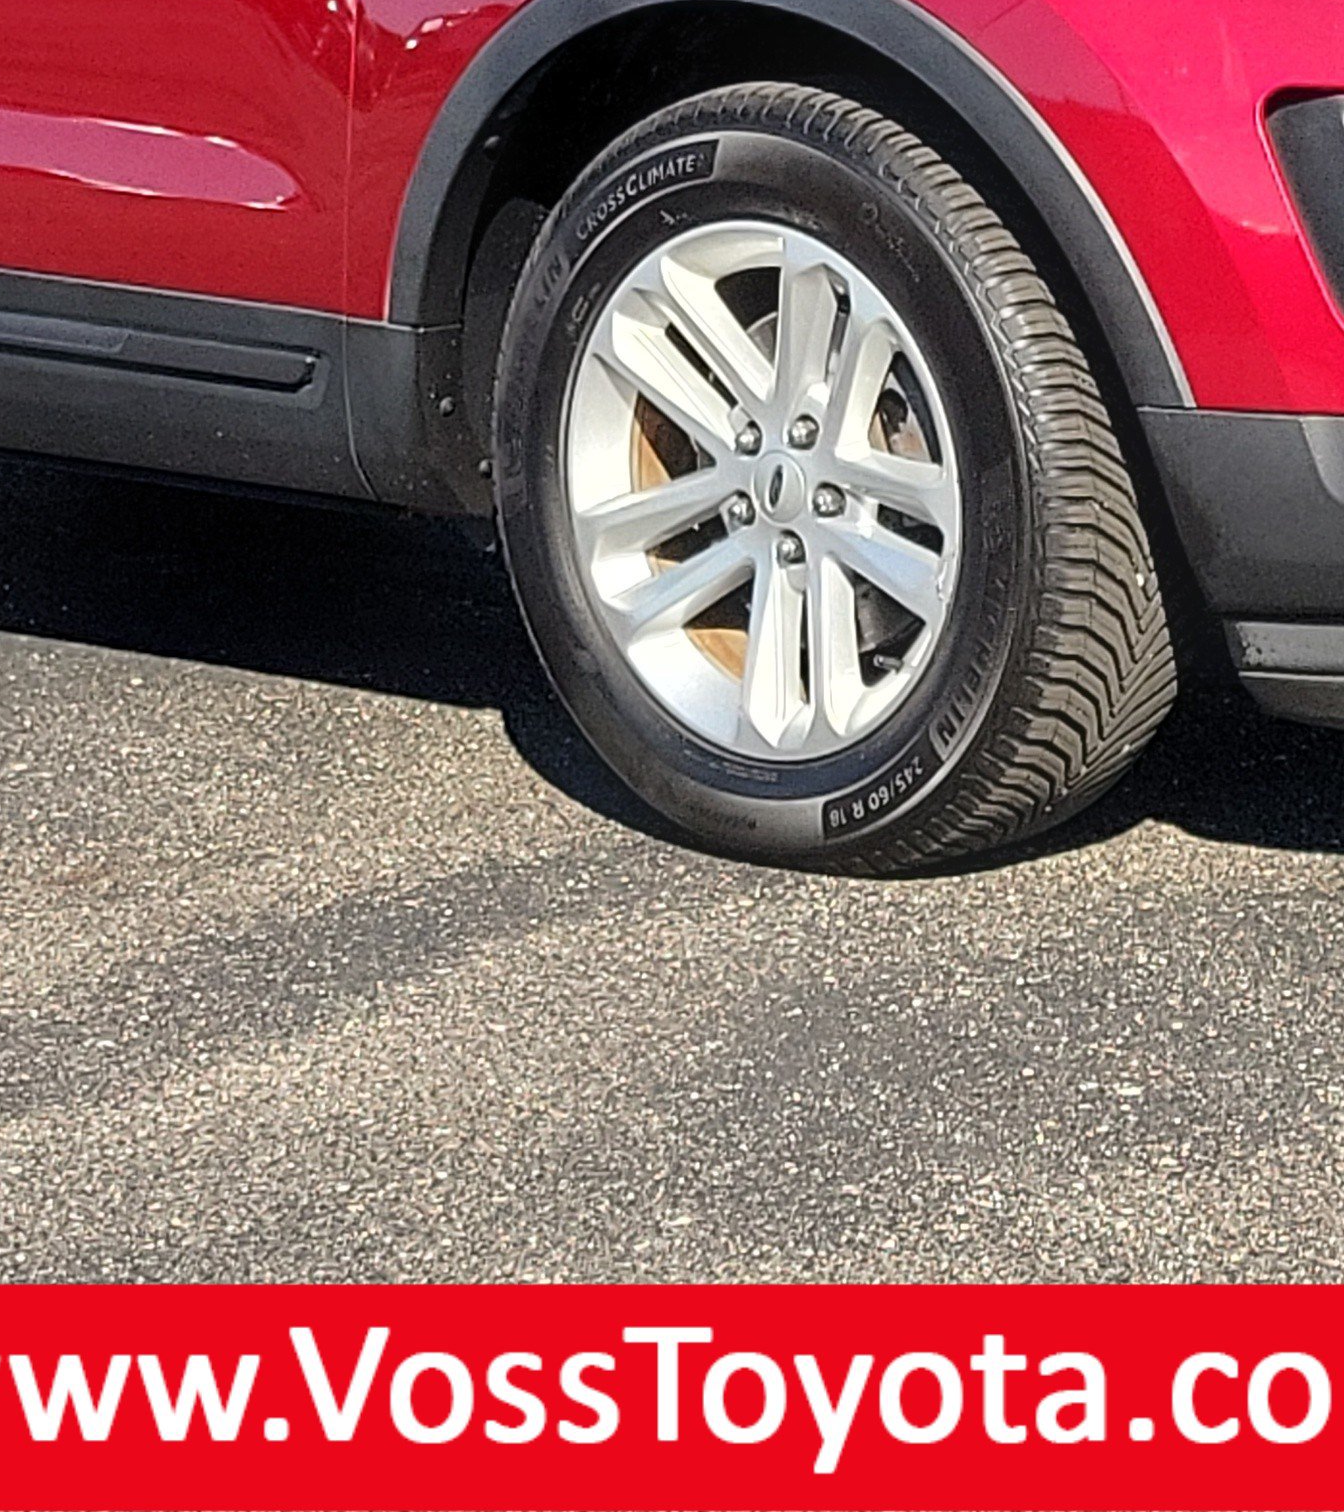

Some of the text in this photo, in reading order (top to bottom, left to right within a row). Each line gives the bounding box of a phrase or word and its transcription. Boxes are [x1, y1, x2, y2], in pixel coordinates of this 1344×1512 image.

[575, 153, 697, 241] CROSSCLIMATE
[828, 754, 925, 829] 245/60 R 18
